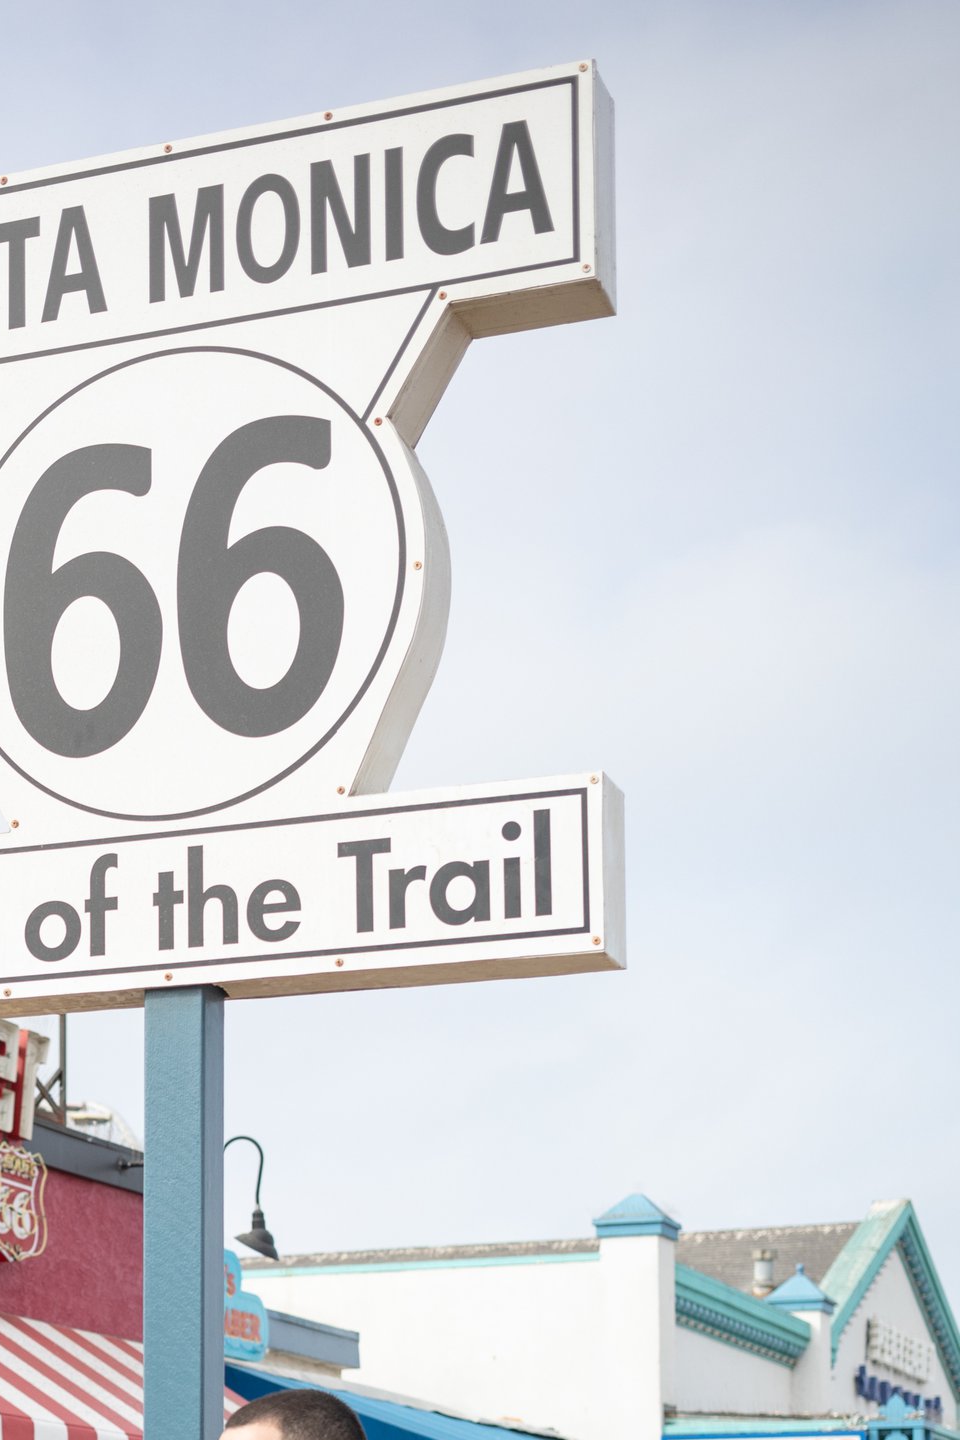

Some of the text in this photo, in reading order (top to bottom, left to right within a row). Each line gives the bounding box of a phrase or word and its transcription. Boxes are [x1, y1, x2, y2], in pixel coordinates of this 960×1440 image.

[148, 120, 555, 303] MONICA
[3, 414, 345, 758] 66
[24, 853, 118, 962] of
[153, 845, 301, 951] the
[337, 809, 552, 935] Trail
